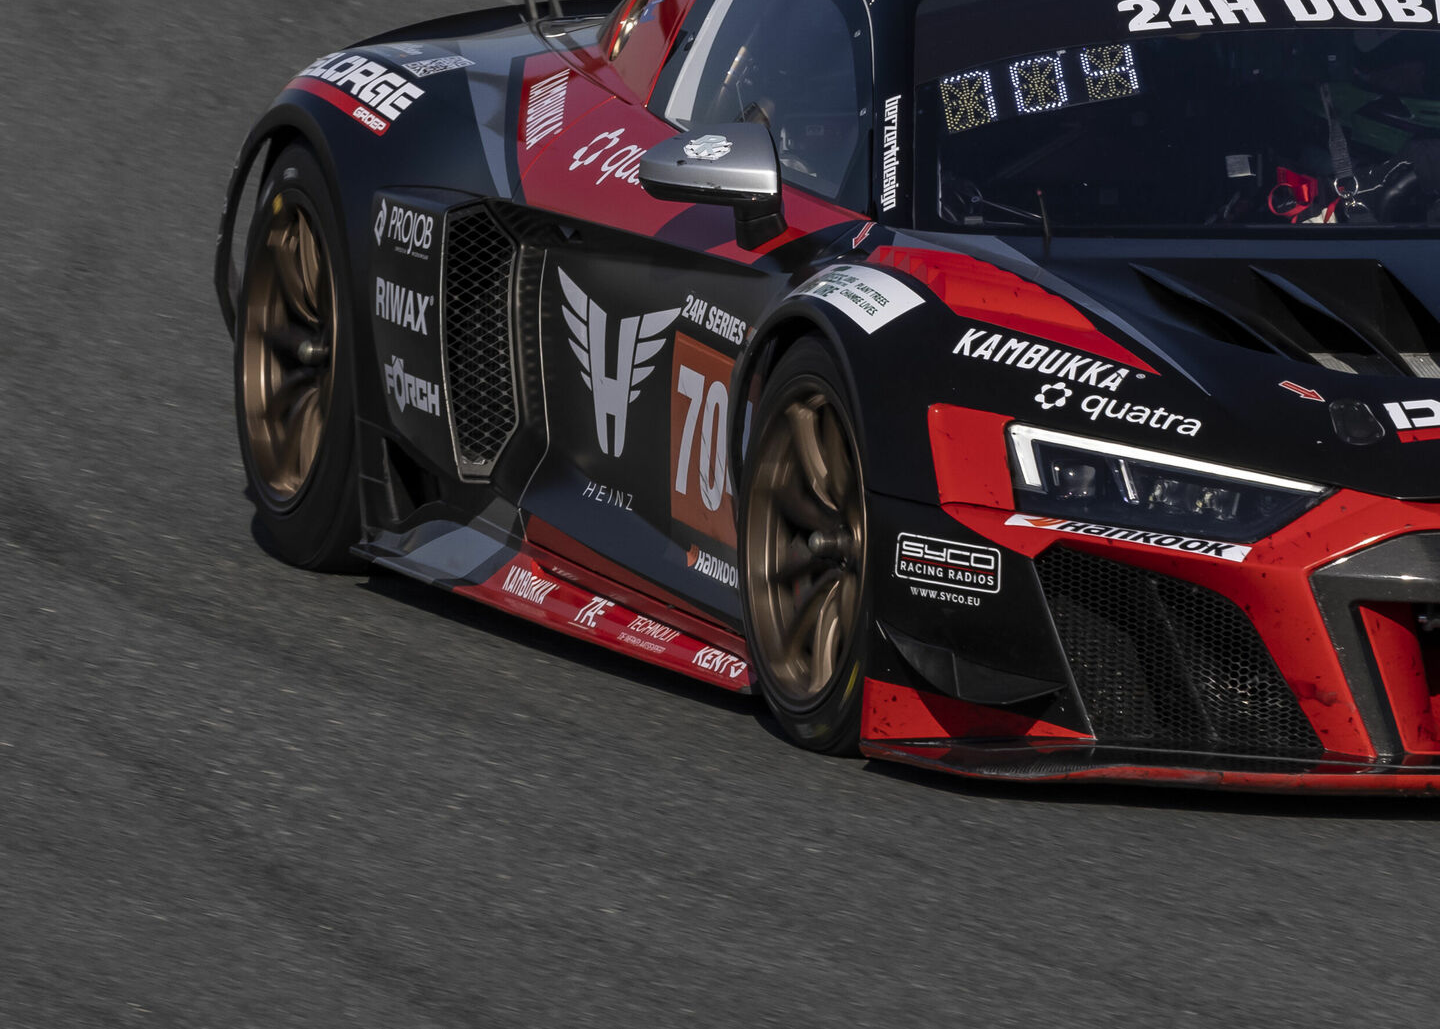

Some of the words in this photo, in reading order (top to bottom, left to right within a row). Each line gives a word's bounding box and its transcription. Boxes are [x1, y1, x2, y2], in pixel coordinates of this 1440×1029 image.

[352, 106, 387, 131] GROEP
[879, 94, 902, 213] berzerkdesign
[387, 205, 434, 256] PROJOB
[375, 275, 431, 336] RIWAX
[839, 288, 864, 304] CHANGE
[854, 281, 875, 298] PLANT
[681, 294, 707, 326] 24H
[705, 305, 748, 346] SERIES
[952, 327, 1130, 393] KAMBUKKA
[1081, 394, 1202, 438] quatra
[674, 364, 734, 512] 70
[582, 480, 634, 512] HEINZ
[900, 560, 944, 578] RACING
[948, 570, 995, 587] RADIOS
[901, 540, 995, 570] SYCO
[910, 586, 981, 607] WWW.SYCO.EU
